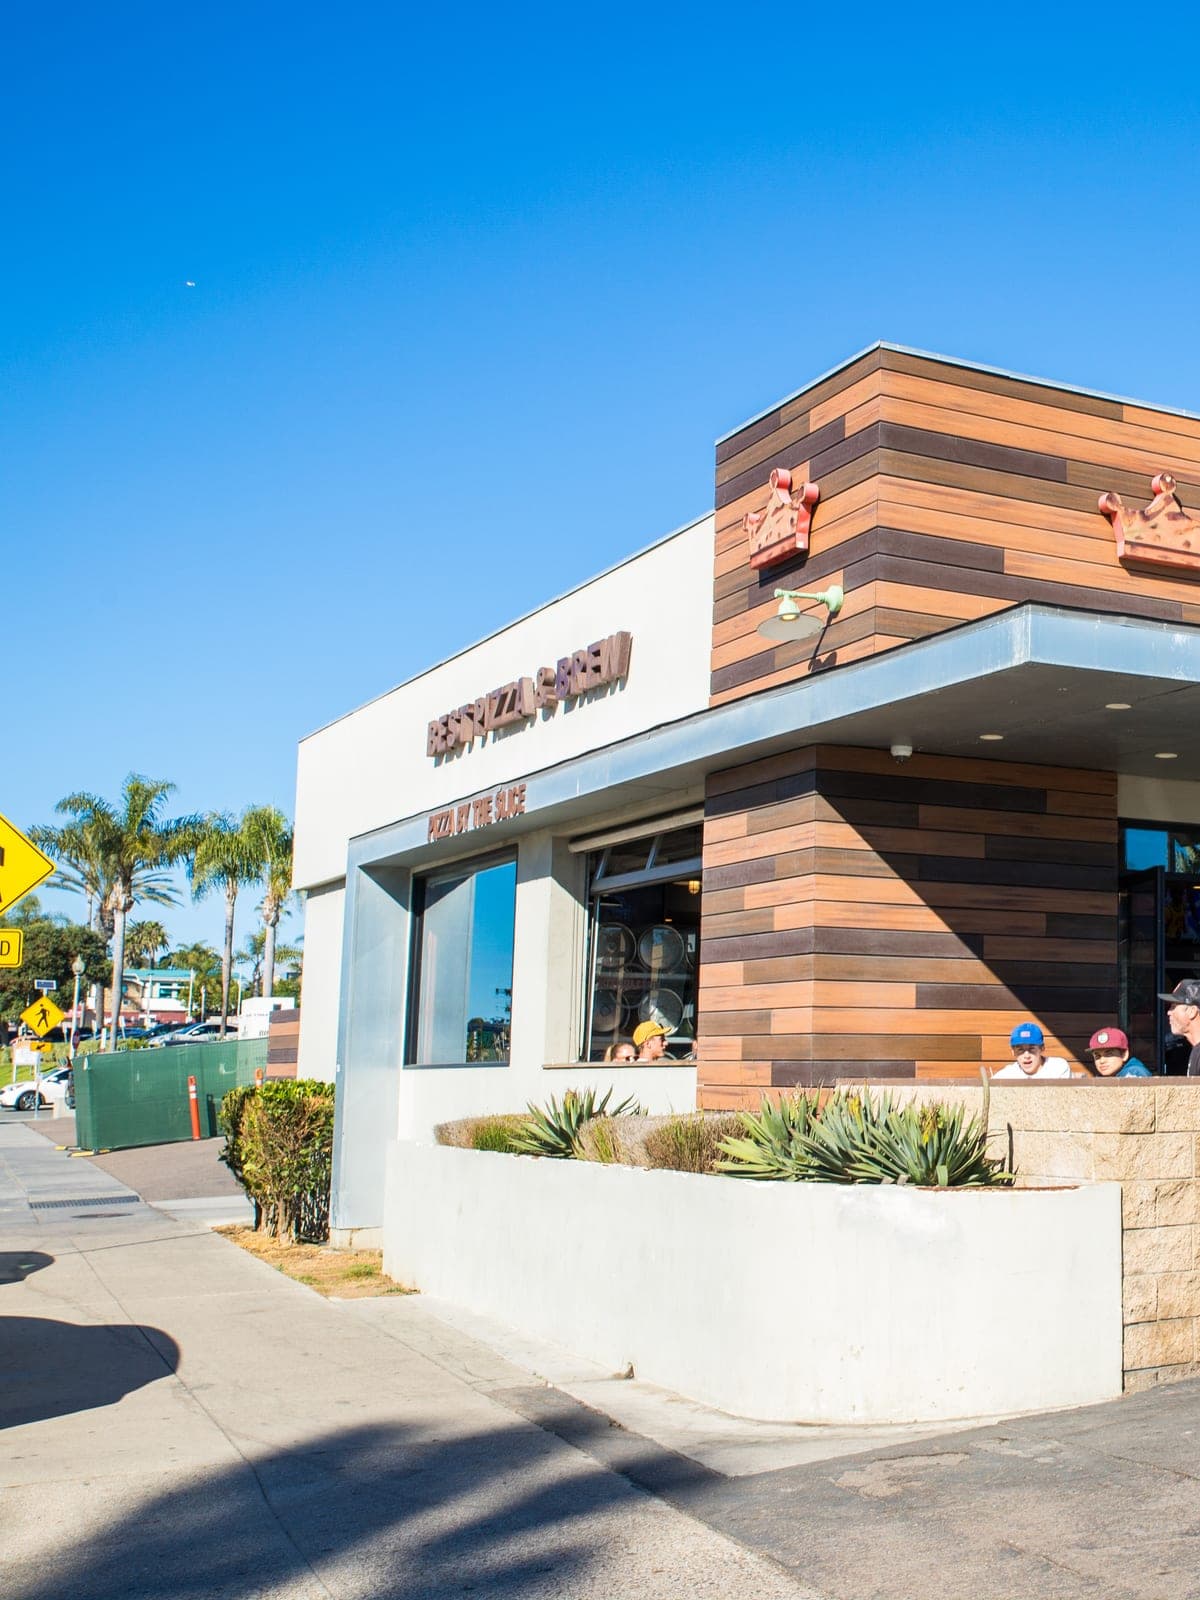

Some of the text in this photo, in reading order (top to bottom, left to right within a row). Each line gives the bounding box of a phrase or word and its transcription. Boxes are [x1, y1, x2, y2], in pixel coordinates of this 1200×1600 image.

[427, 631, 632, 757] BEST PIZZA & BREW
[428, 783, 527, 842] PIZZA BY THE SLICE
